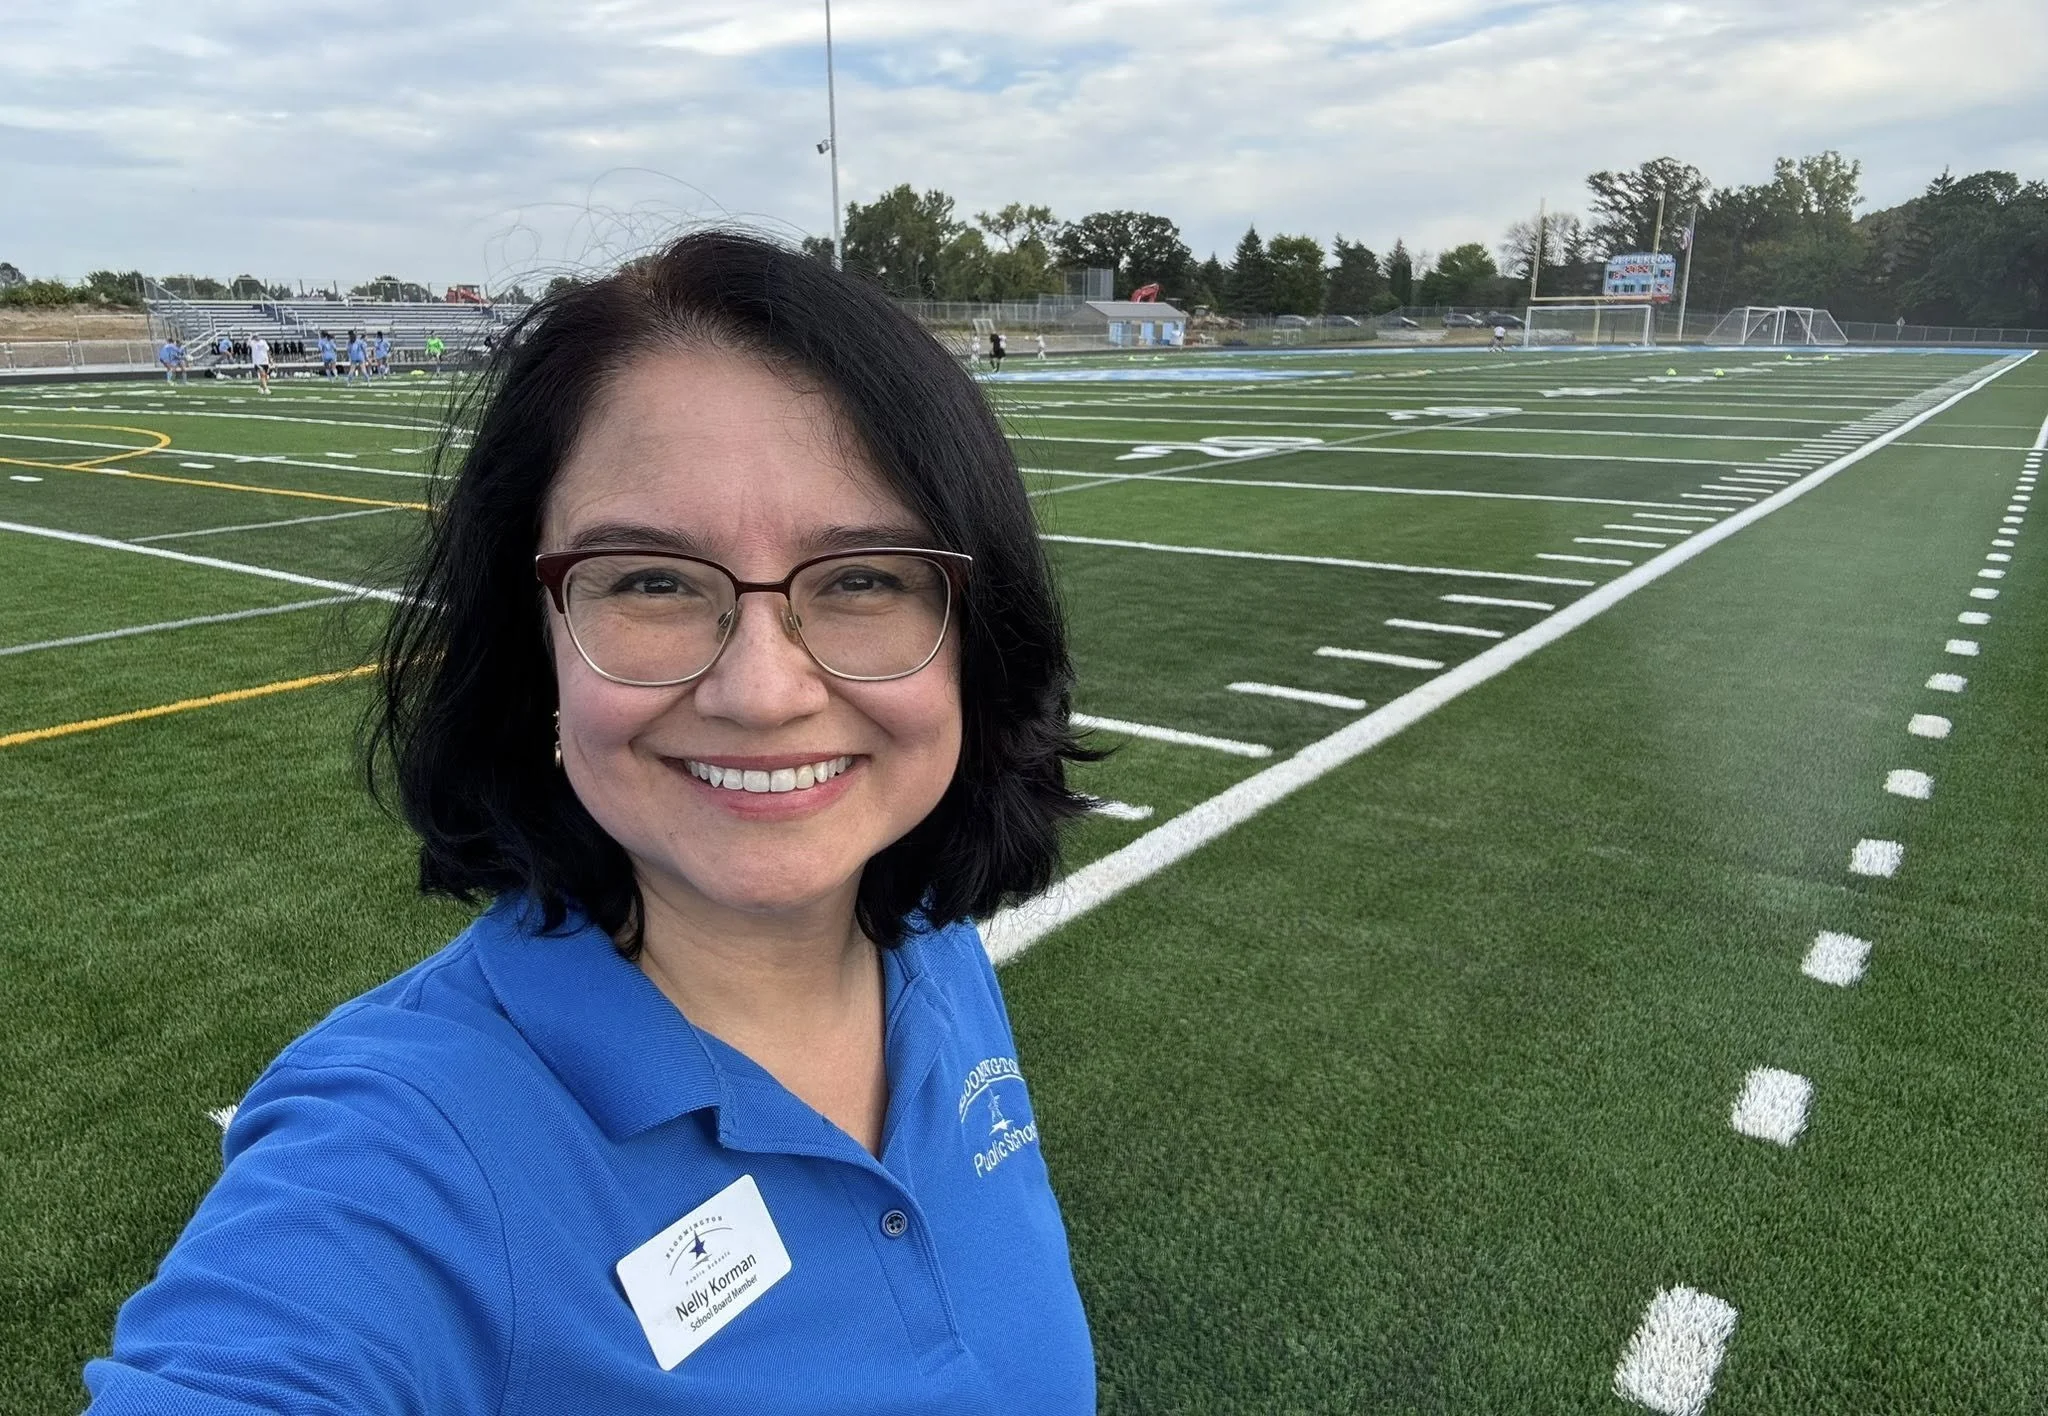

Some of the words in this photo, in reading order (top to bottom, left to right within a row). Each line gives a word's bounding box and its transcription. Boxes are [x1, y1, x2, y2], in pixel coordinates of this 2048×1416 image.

[973, 1140, 1008, 1178] Public
[665, 1215, 724, 1259] BLOOMINGTON
[674, 1285, 711, 1323] Nelly
[707, 1252, 757, 1297] Korman
[690, 1307, 714, 1332] School
[713, 1294, 733, 1314] Board
[731, 1274, 758, 1299] Member
